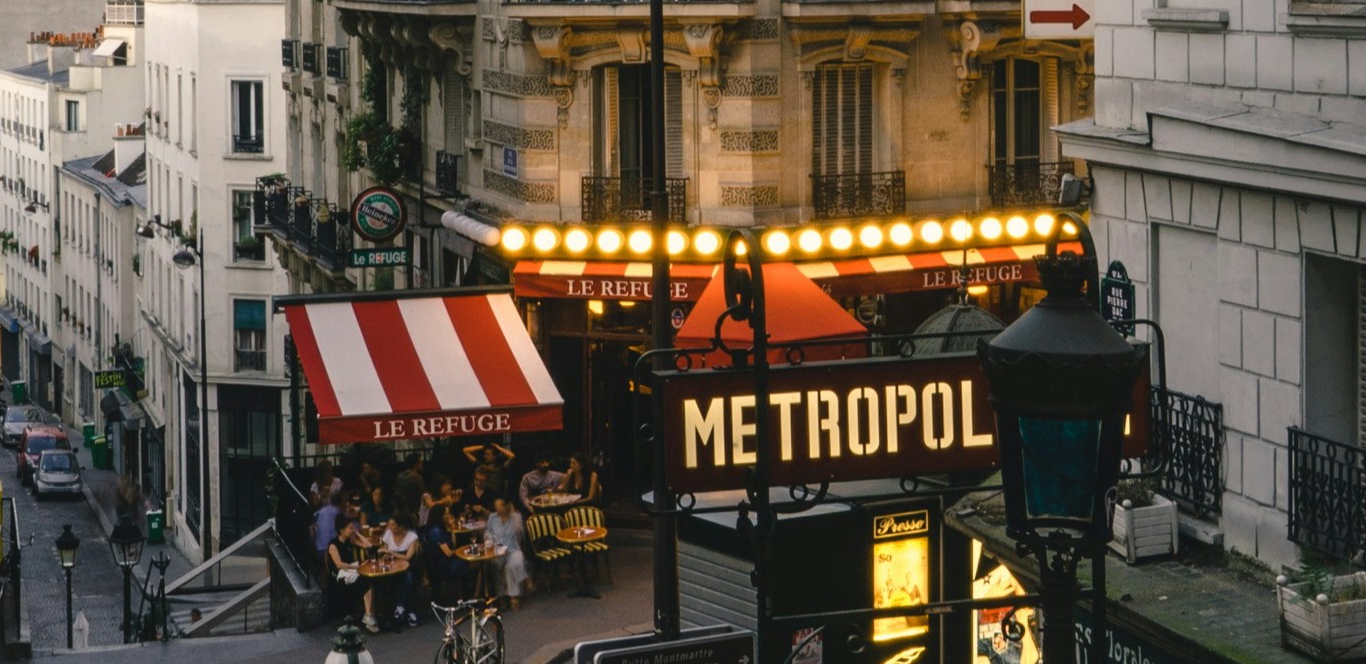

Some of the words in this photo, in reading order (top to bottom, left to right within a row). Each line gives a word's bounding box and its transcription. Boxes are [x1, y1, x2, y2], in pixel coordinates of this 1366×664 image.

[361, 204, 396, 226] Heineken
[354, 253, 366, 265] Le
[368, 251, 406, 265] REFUGE
[922, 271, 946, 288] LE
[567, 279, 594, 296] LE
[600, 280, 688, 298] REFUE
[1111, 287, 1123, 298] RUE
[1107, 295, 1128, 310] PIERRE
[1112, 306, 1123, 317] DAC
[373, 419, 406, 439] LE
[412, 413, 511, 436] REFUGE
[654, 649, 714, 664] Montmartre
